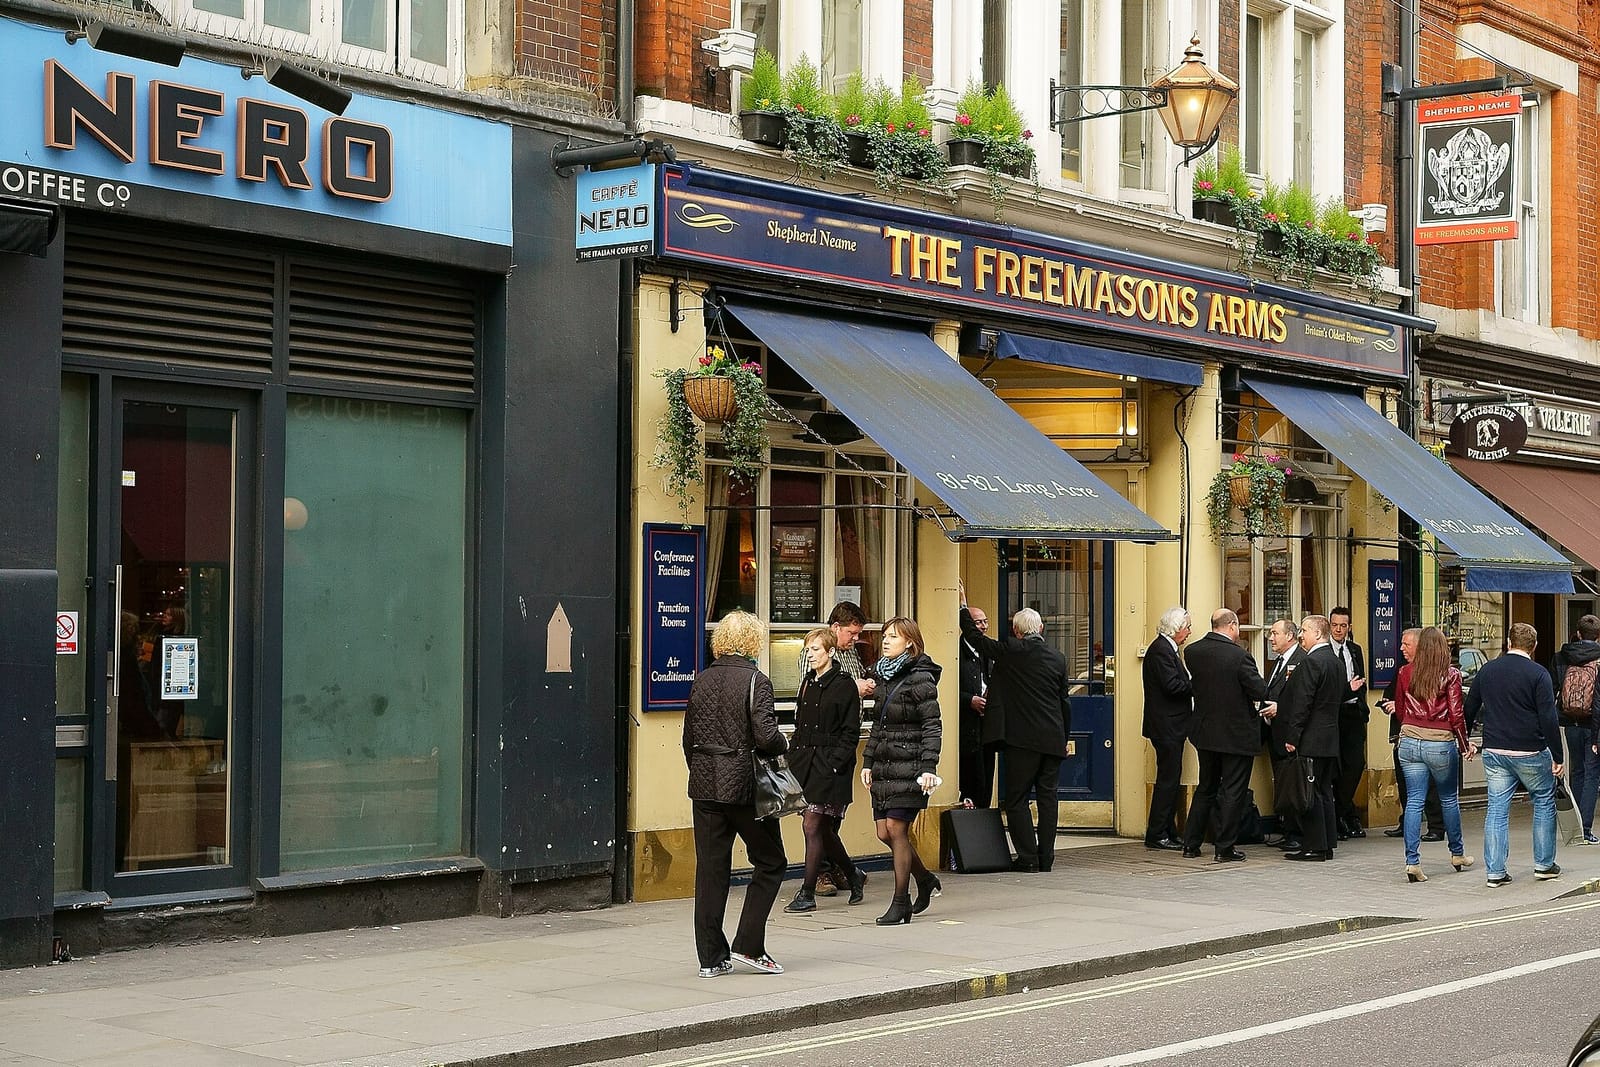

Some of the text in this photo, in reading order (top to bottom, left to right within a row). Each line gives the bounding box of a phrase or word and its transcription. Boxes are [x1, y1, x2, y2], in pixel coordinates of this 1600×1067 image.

[1424, 101, 1511, 117] SHEPHERD NEAME
[44, 58, 394, 203] NERO
[579, 204, 649, 235] NERO
[767, 219, 857, 252] Shepherd Neame
[1419, 225, 1509, 239] THE FREEMASONS ARMS
[580, 250, 591, 259] THE
[592, 247, 616, 258] ITALIAN
[616, 244, 639, 255] COFFEE
[882, 225, 1288, 344] THE FREEMASONS ARMS
[1304, 323, 1328, 339] Britain's
[1459, 405, 1517, 424] PATISSERIE
[1538, 406, 1592, 437] VALERIE
[1467, 447, 1510, 461] VALERIE
[936, 472, 1099, 499] 81-82 Long Acre
[653, 549, 695, 564] Conference
[657, 564, 691, 577] Facilities
[1375, 578, 1394, 591] Quality
[1379, 592, 1389, 603] Hot
[657, 601, 690, 613] Function
[1375, 606, 1393, 617] & Cold
[661, 615, 687, 628] Rooms
[1378, 620, 1391, 631] Food
[666, 656, 681, 668] Air
[1375, 658, 1395, 670] Sky HD
[651, 670, 696, 682] Conditioned
